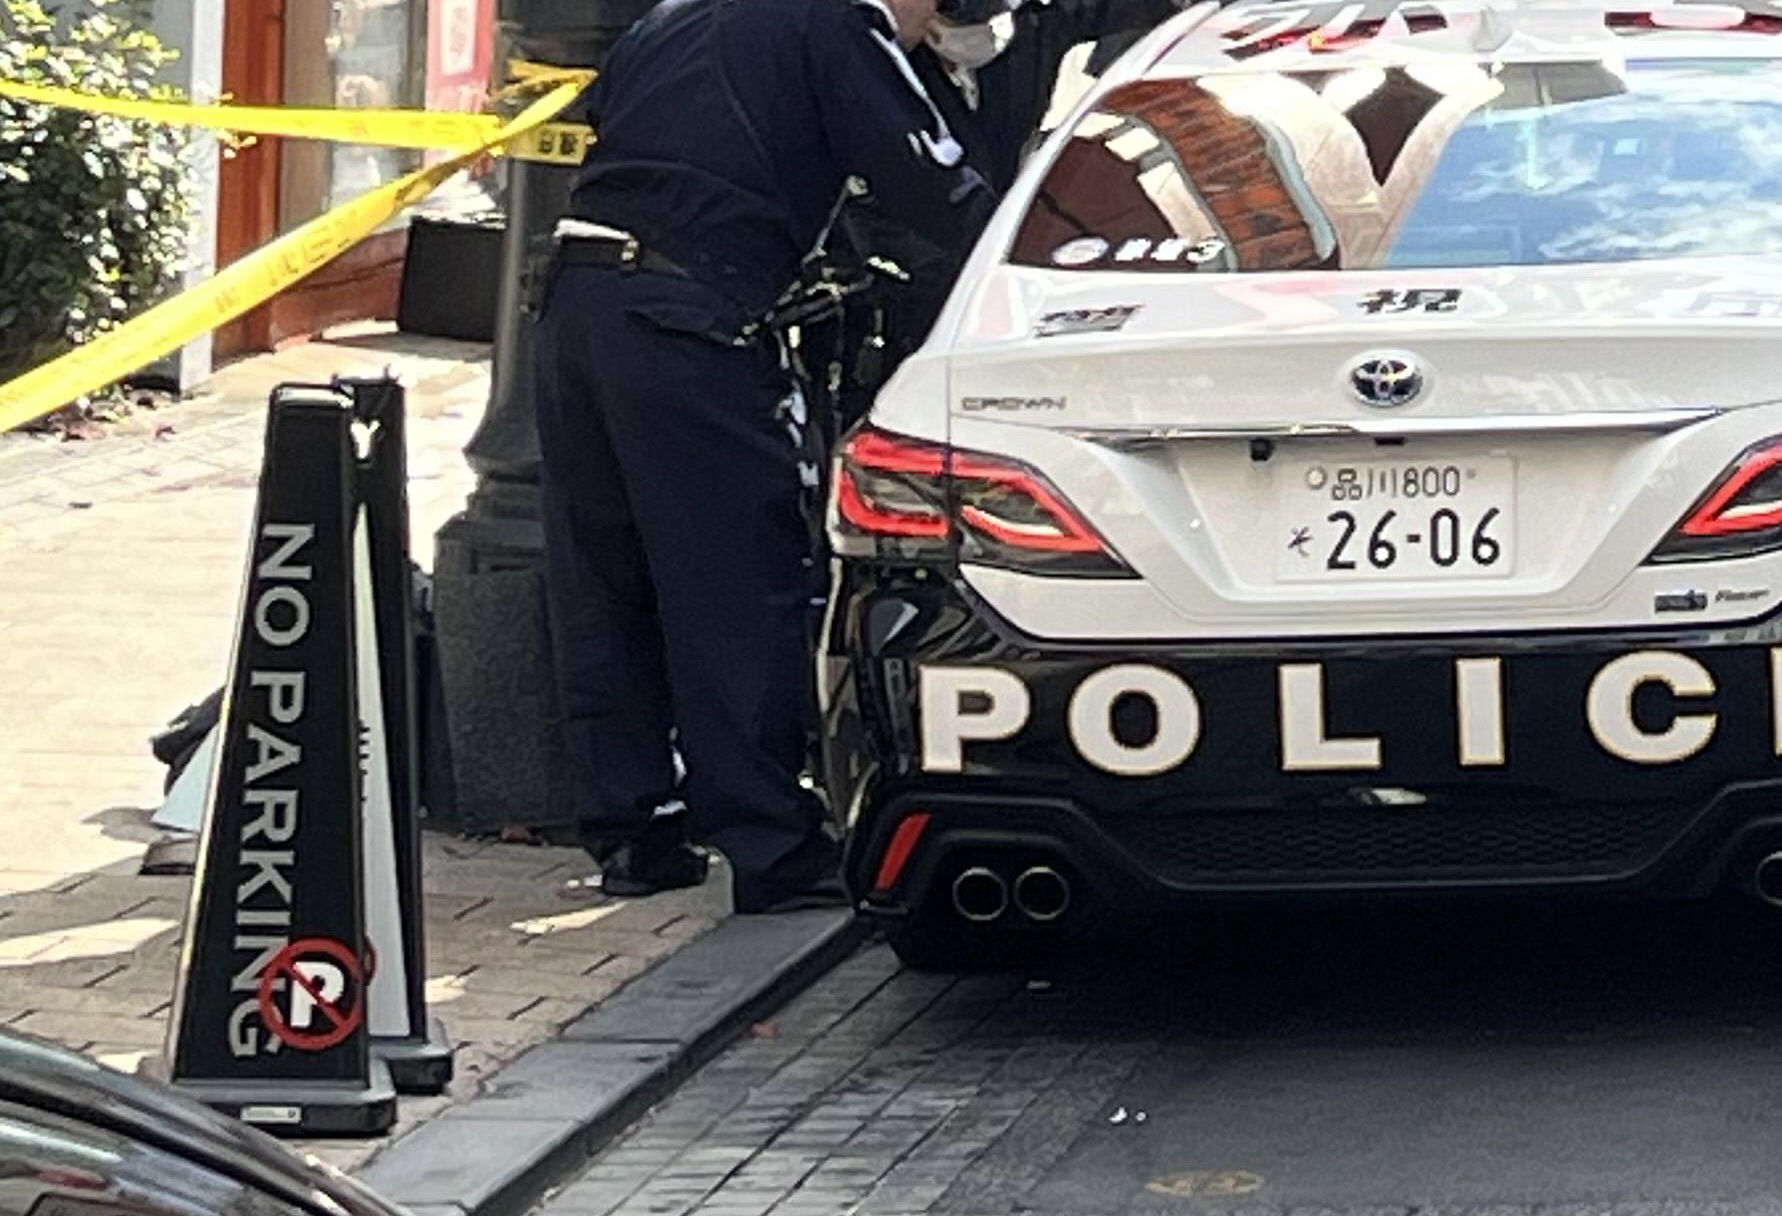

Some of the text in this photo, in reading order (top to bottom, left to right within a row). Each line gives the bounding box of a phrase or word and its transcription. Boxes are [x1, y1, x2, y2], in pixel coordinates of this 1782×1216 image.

[961, 396, 1067, 411] CROWN
[255, 522, 316, 646] NO
[1326, 507, 1501, 571] 26-06
[228, 670, 307, 1059] PARKING
